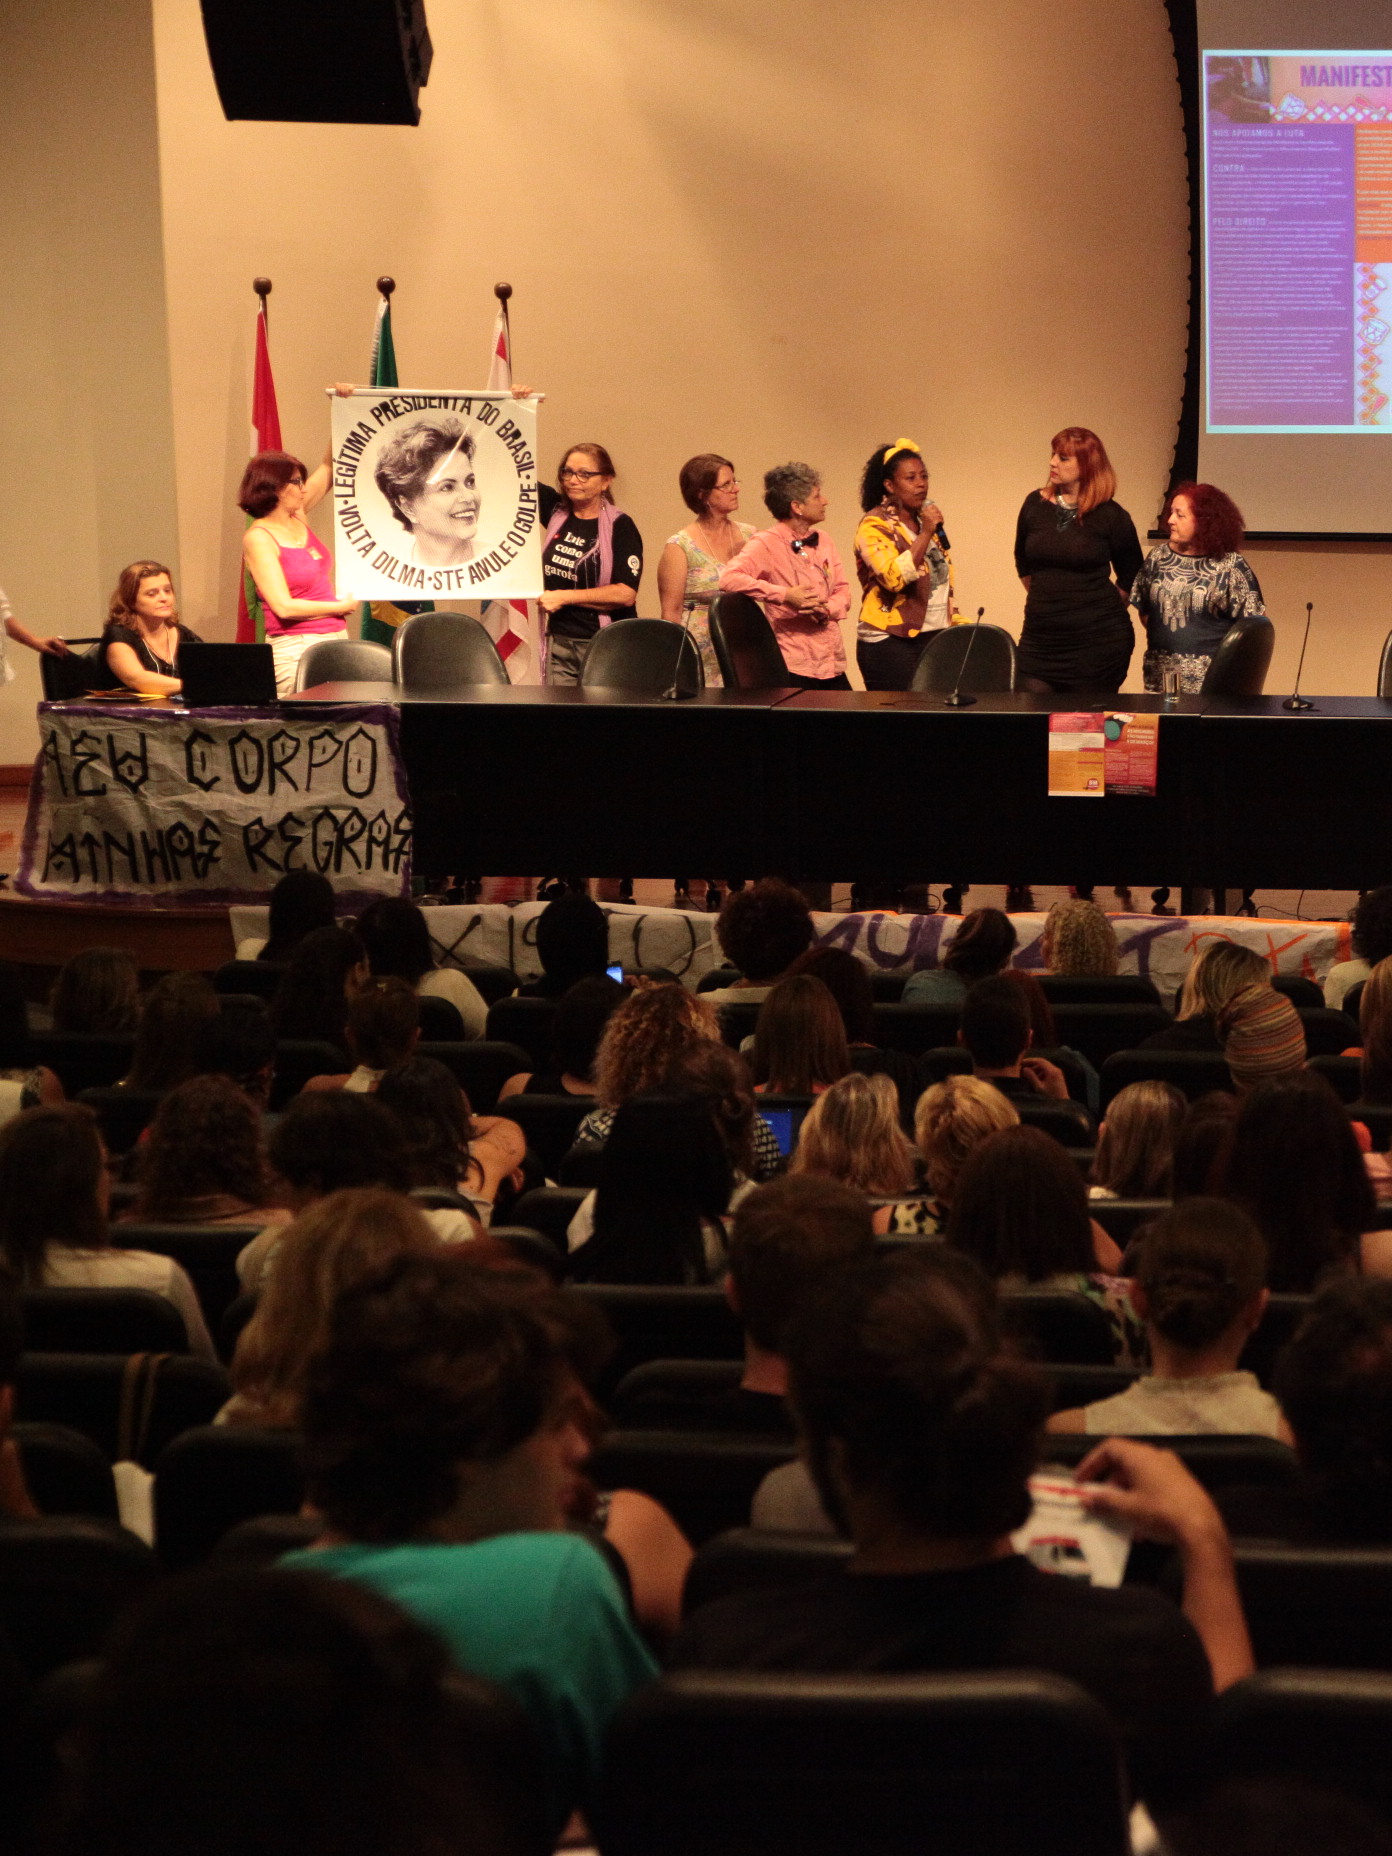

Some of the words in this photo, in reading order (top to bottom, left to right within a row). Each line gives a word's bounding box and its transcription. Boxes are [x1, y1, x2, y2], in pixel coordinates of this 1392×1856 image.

[335, 421, 377, 499] LEGÍTIMA
[370, 396, 472, 428] PRESIDENTA
[477, 402, 501, 427] DO
[495, 419, 536, 479] BRASIL
[516, 482, 538, 535] GOLPE
[338, 504, 377, 559] VOLTA
[371, 550, 424, 590] DILMA
[507, 531, 526, 548] O
[555, 543, 583, 558] como
[468, 540, 518, 586] ANULE
[544, 564, 578, 582] garota
[551, 555, 575, 568] uma
[433, 568, 465, 591] STF
[184, 726, 378, 799] CORPO
